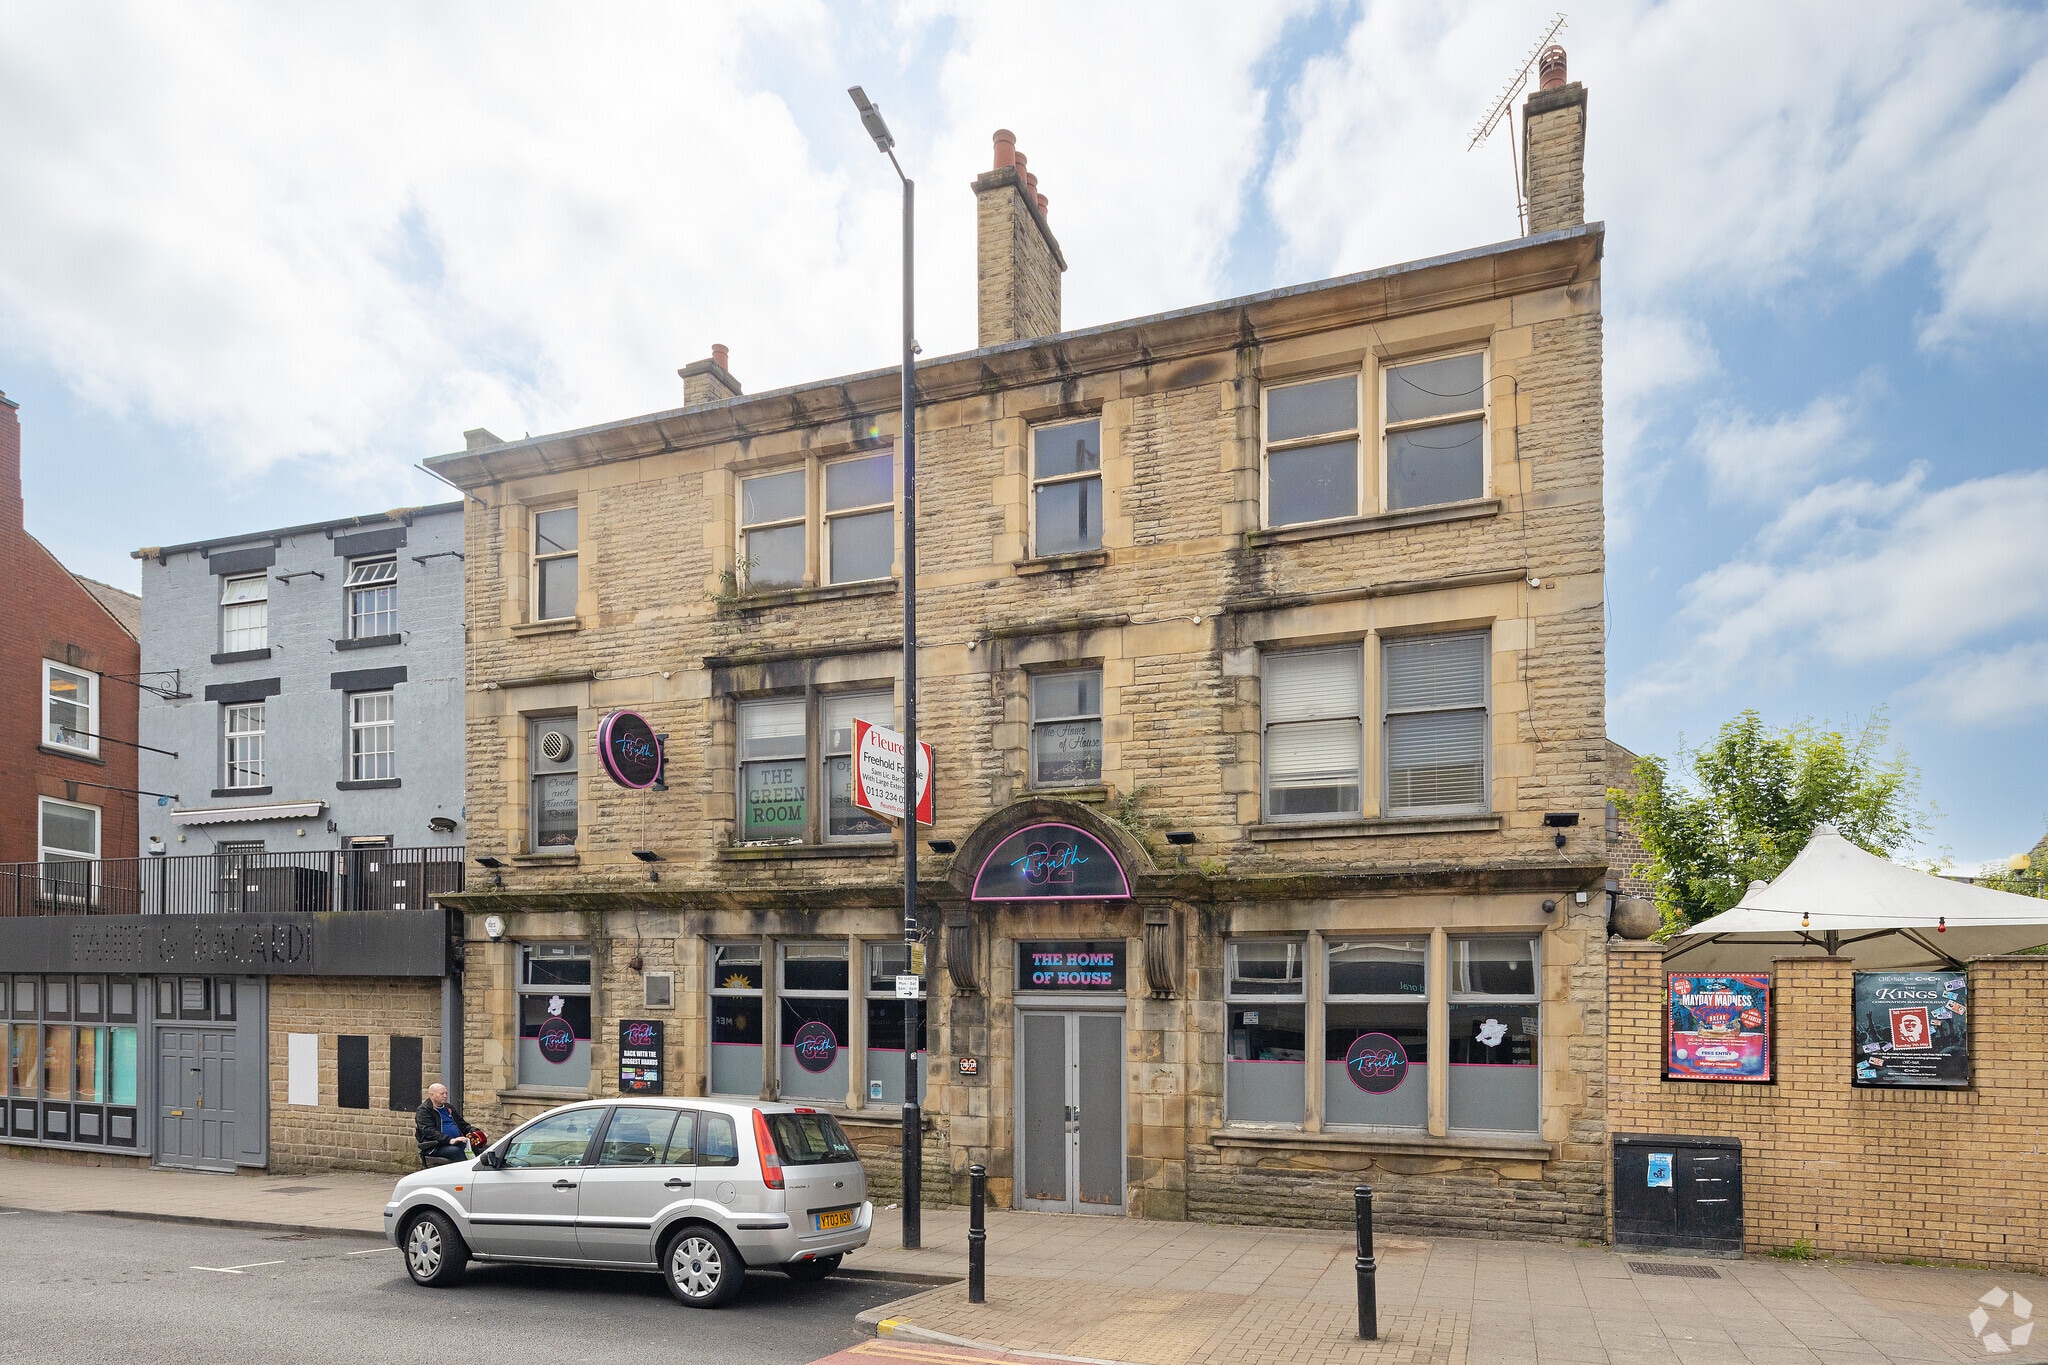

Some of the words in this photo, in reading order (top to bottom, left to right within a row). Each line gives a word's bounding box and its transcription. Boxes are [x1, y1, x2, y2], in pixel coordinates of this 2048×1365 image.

[1056, 724, 1087, 738] Home
[615, 739, 655, 757] Truth
[871, 730, 905, 756] Fleure
[1059, 737, 1067, 752] of
[1069, 736, 1100, 750] House
[864, 751, 894, 770] Freehold
[761, 769, 793, 785] THE
[862, 772, 875, 782] With
[876, 777, 890, 787] Large
[871, 767, 882, 777] 5am
[548, 777, 577, 788] Event
[552, 789, 569, 797] and
[750, 786, 805, 805] GREEN
[866, 785, 883, 798] 0113
[885, 791, 898, 802] 234
[548, 809, 574, 819] Room
[753, 805, 802, 823] ROOM
[1010, 844, 1089, 874] Truth
[1025, 841, 1074, 886] 32
[1032, 953, 1063, 966] THE
[1066, 953, 1114, 966] HOME
[1032, 971, 1054, 985] OF
[1057, 971, 1112, 985] HOUSE
[1683, 994, 1713, 1006] MAYDAY
[1714, 994, 1752, 1007] MADNESS
[540, 1032, 573, 1047] Truth
[622, 1025, 657, 1040] Truth
[795, 1038, 835, 1054] Truth
[803, 1035, 828, 1059] 32
[1348, 1052, 1405, 1071] Truth
[1360, 1048, 1395, 1078] 32
[820, 1213, 839, 1228] YT03
